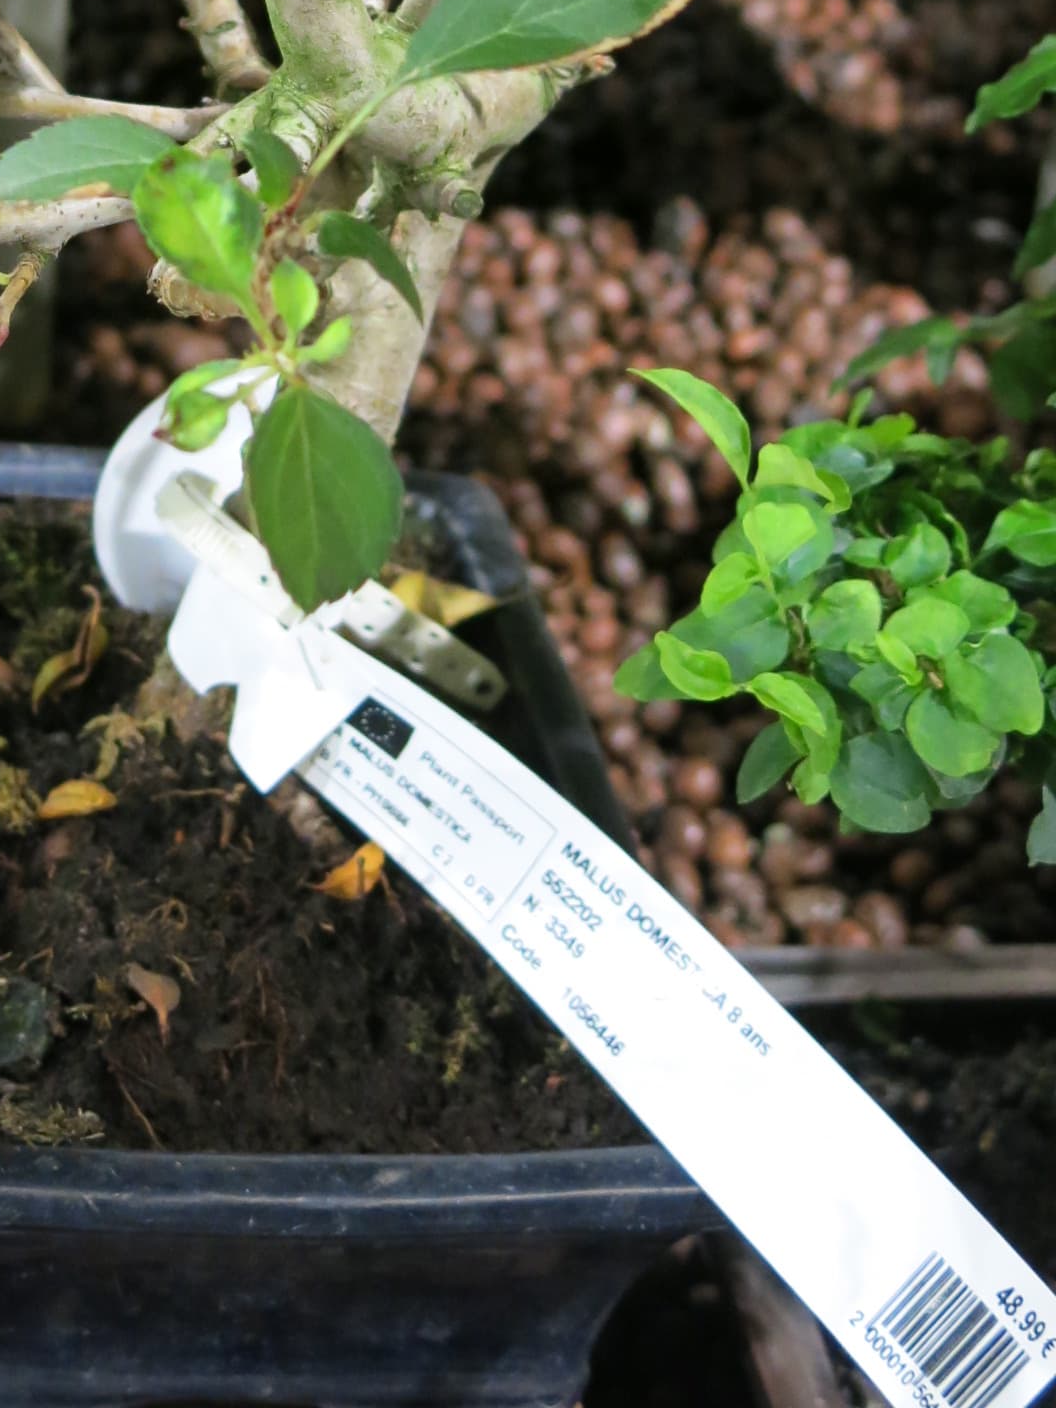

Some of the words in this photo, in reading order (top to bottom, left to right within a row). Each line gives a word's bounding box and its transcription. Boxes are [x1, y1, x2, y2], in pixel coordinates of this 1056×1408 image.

[349, 737, 394, 778] MALUS
[397, 775, 472, 843] DOMESTICA
[419, 750, 459, 788] Plant
[461, 783, 526, 845] Passport
[542, 869, 603, 932] 552202
[544, 915, 586, 959] 3349
[561, 841, 627, 907] MALUS
[626, 902, 728, 1011] DOMESTA
[727, 1006, 743, 1023] 8
[740, 1021, 773, 1057] ans
[501, 923, 542, 970] Code
[561, 986, 626, 1058] 1056446
[848, 1309, 865, 1328] 2
[863, 1326, 914, 1386] 000010
[912, 1383, 942, 1408] 56
[996, 1286, 1046, 1342] 48.99
[1041, 1337, 1056, 1359] €
